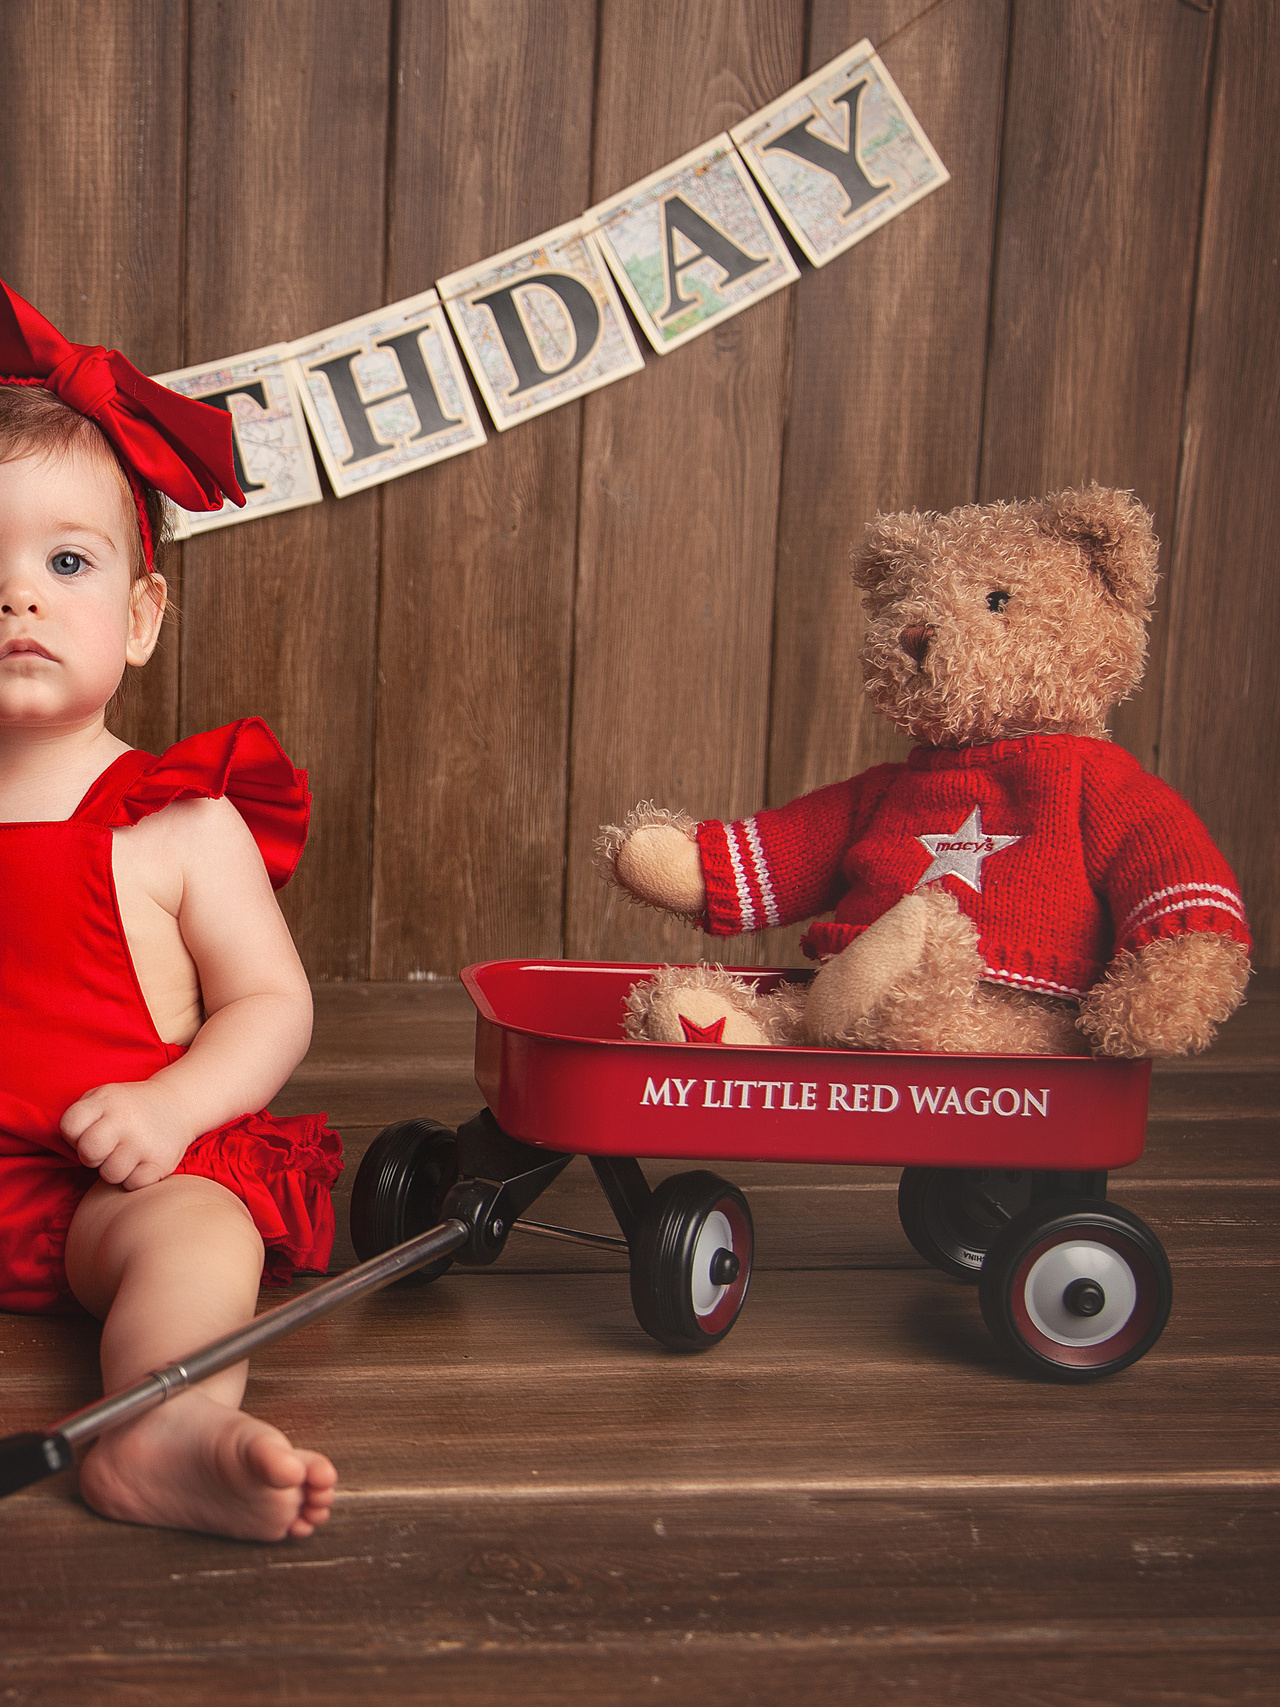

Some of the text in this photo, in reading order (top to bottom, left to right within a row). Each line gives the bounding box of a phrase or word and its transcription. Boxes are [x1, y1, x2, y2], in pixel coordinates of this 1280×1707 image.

[935, 836, 995, 853] macy's
[639, 1076, 1050, 1117] MY LITTLE RED WAGON
